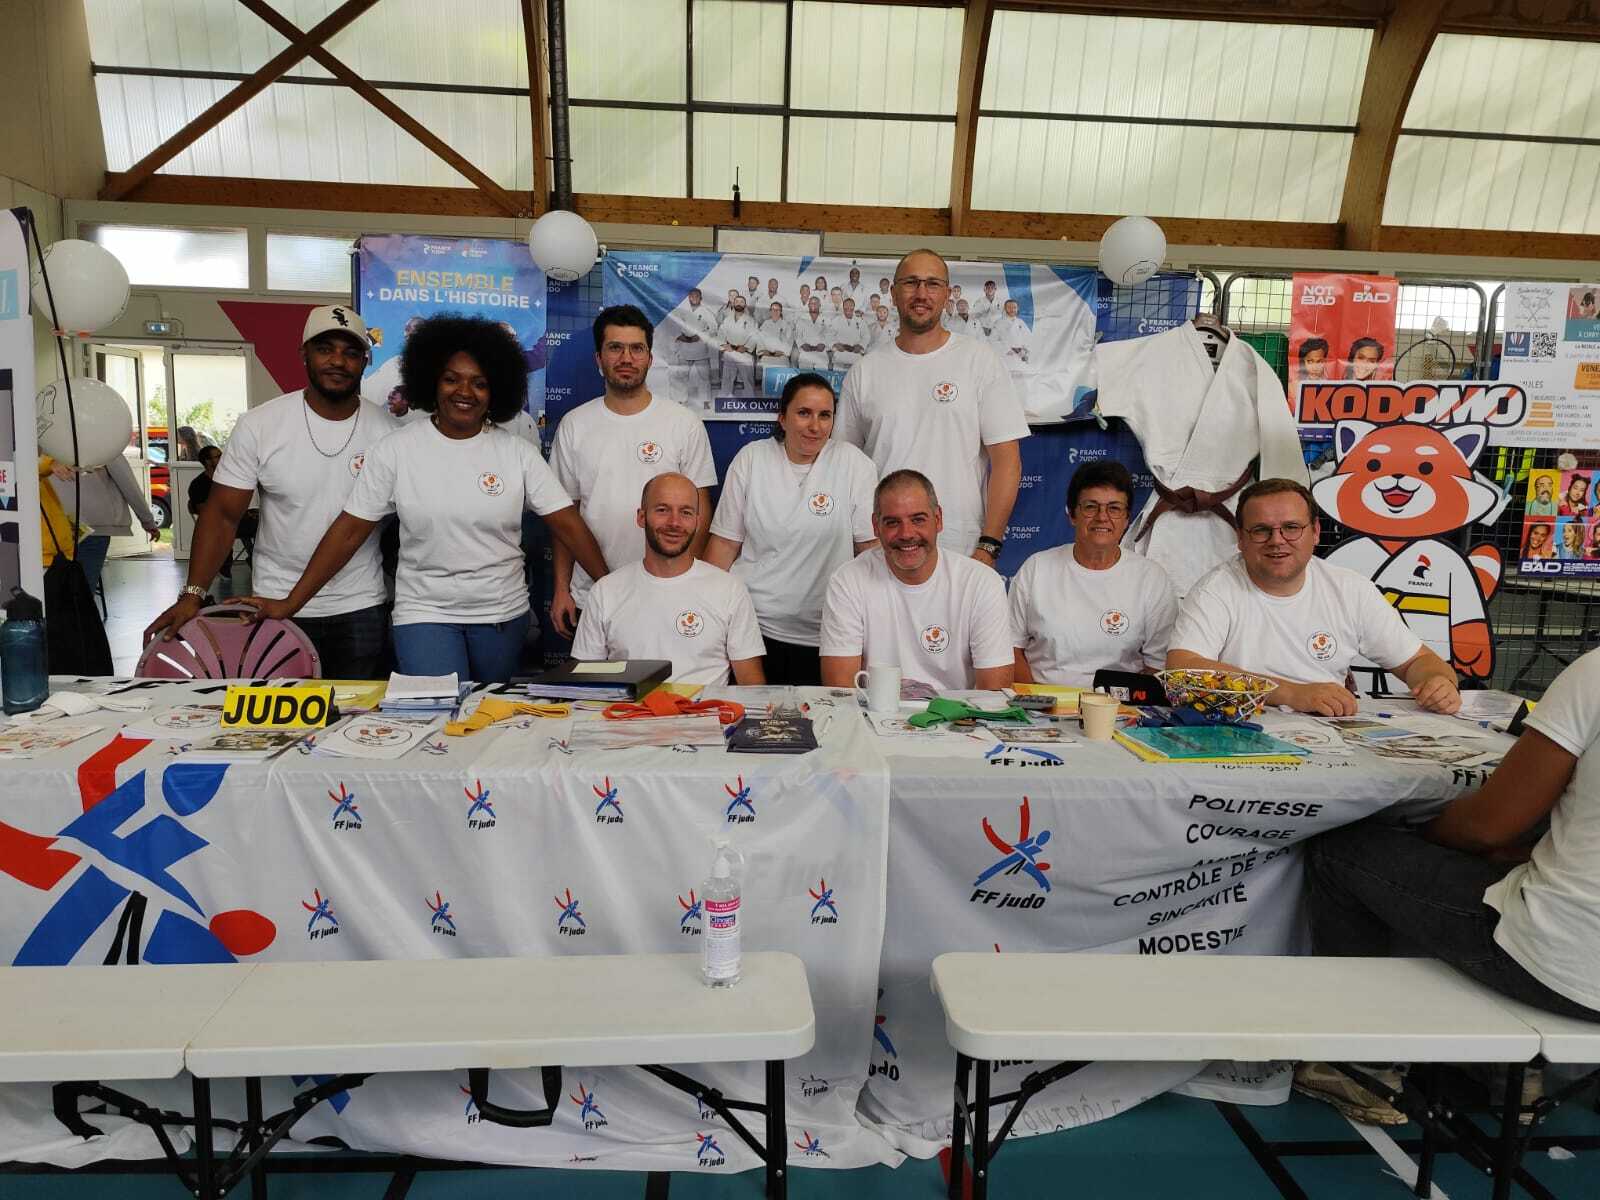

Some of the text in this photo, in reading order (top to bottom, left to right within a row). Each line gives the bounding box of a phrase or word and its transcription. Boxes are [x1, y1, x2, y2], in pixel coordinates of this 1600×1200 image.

[628, 264, 658, 272] FRANCE
[396, 269, 514, 292] ENSEMBLE
[1303, 285, 1335, 296] NOT
[379, 288, 530, 308] DANS L'HISTOIRE
[1301, 296, 1336, 305] BAD
[1352, 292, 1391, 303] BAD
[545, 387, 572, 395] RANCE
[721, 401, 779, 410] JEUX OLYM
[1301, 384, 1526, 426] KODOMO
[1521, 561, 1562, 573] BAD
[223, 695, 327, 725] JUDO
[1188, 794, 1323, 818] POLITESSE
[727, 815, 738, 823] FF
[334, 820, 345, 830] FF
[468, 819, 496, 831] FF judo
[1186, 823, 1297, 844] COURAGE
[1112, 866, 1222, 907] CONTRÔLE
[1230, 857, 1257, 877] DE
[970, 889, 1046, 909] FF judo
[811, 915, 837, 925] FF judo
[310, 927, 339, 940] FF judo
[433, 925, 443, 934] FF
[559, 926, 586, 936] FF judo
[681, 926, 702, 936] FF ju
[1138, 924, 1248, 955] MODESTIE
[868, 1060, 900, 1082] udo
[804, 1088, 813, 1097] FF
[467, 1114, 478, 1125] FF
[699, 1158, 710, 1167] FF
